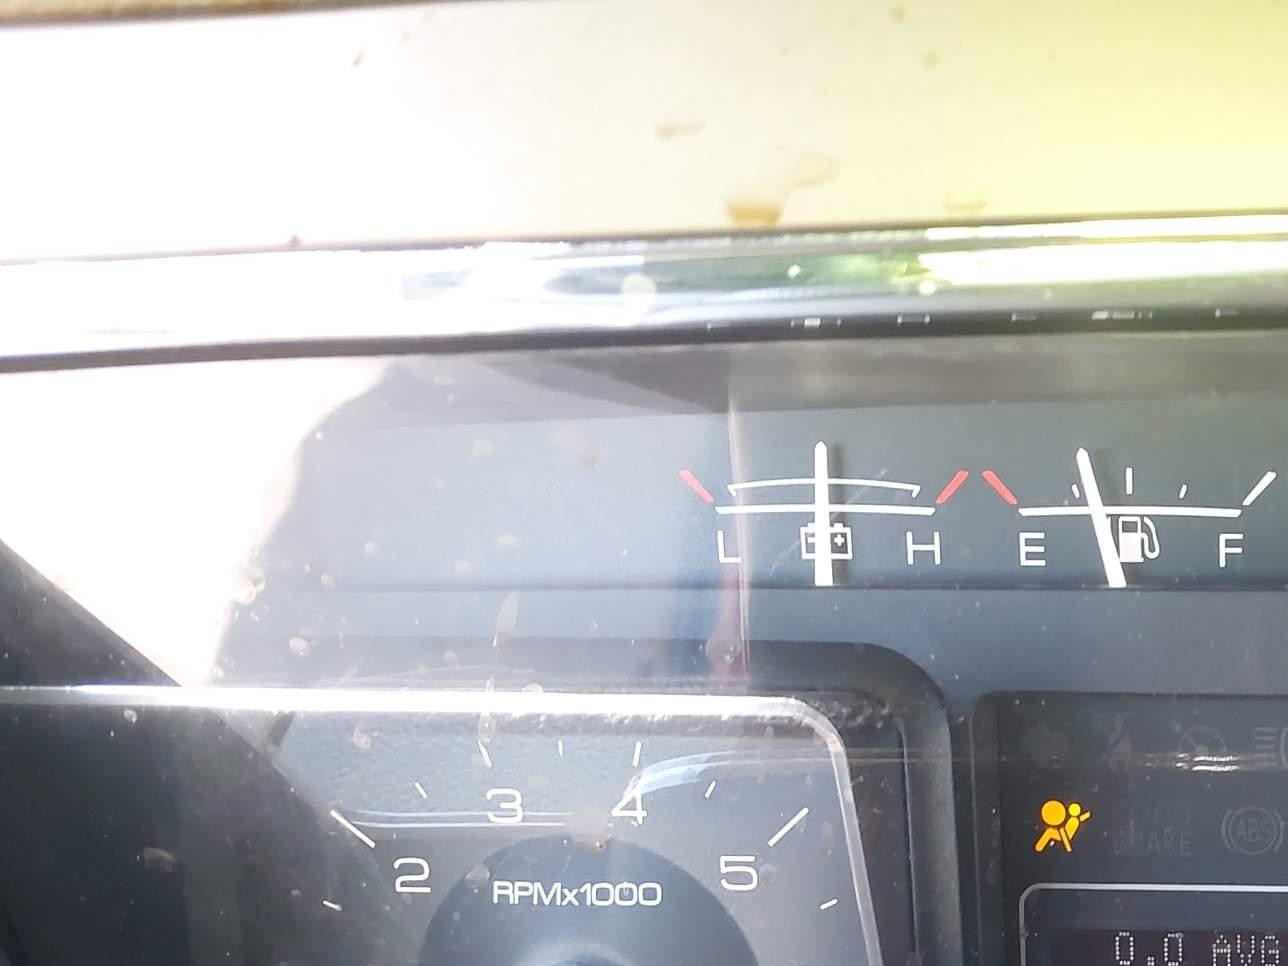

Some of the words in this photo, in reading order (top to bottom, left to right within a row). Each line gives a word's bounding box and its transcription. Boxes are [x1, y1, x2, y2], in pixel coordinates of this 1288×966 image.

[717, 529, 743, 564] L
[906, 531, 941, 565] H
[1019, 532, 1046, 567] E
[1219, 533, 1244, 568] F
[485, 788, 524, 824] 3
[610, 786, 648, 825] 4
[1236, 817, 1274, 843] ABS
[393, 857, 432, 893] 2
[719, 855, 758, 891] 5
[493, 880, 662, 907] RPMx1000
[1115, 931, 1183, 966] 0.0
